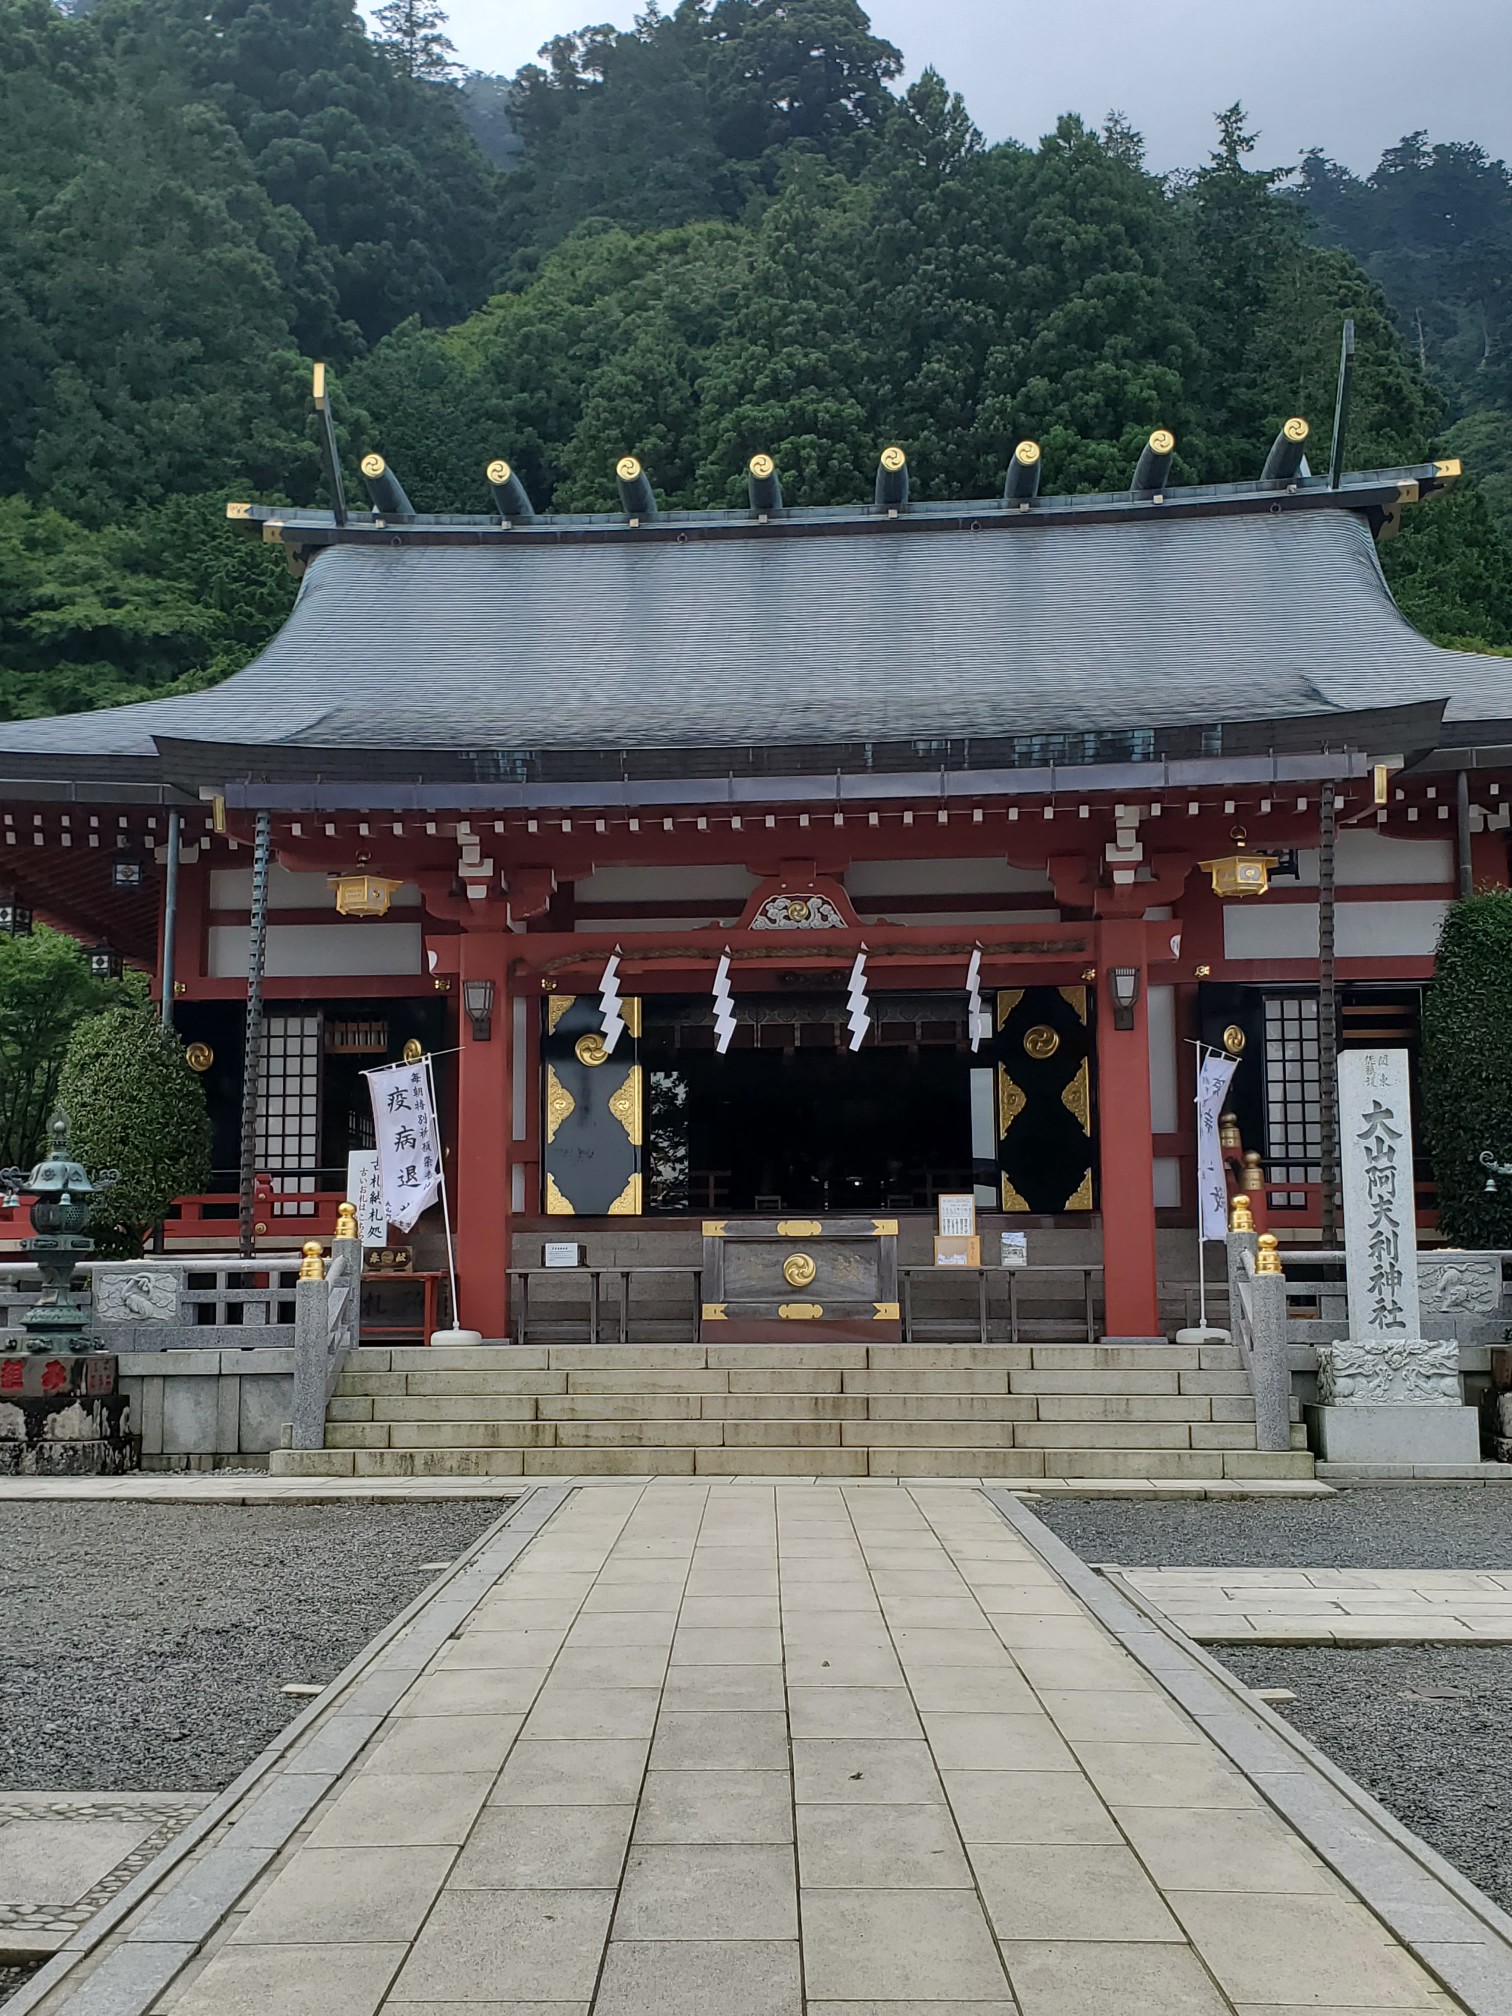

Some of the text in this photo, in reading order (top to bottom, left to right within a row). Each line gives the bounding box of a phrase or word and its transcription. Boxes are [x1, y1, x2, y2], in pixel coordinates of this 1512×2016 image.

[358, 1167, 368, 1247] 古いお札はこちら
[1356, 1099, 1407, 1330] 大山阿夫利神社
